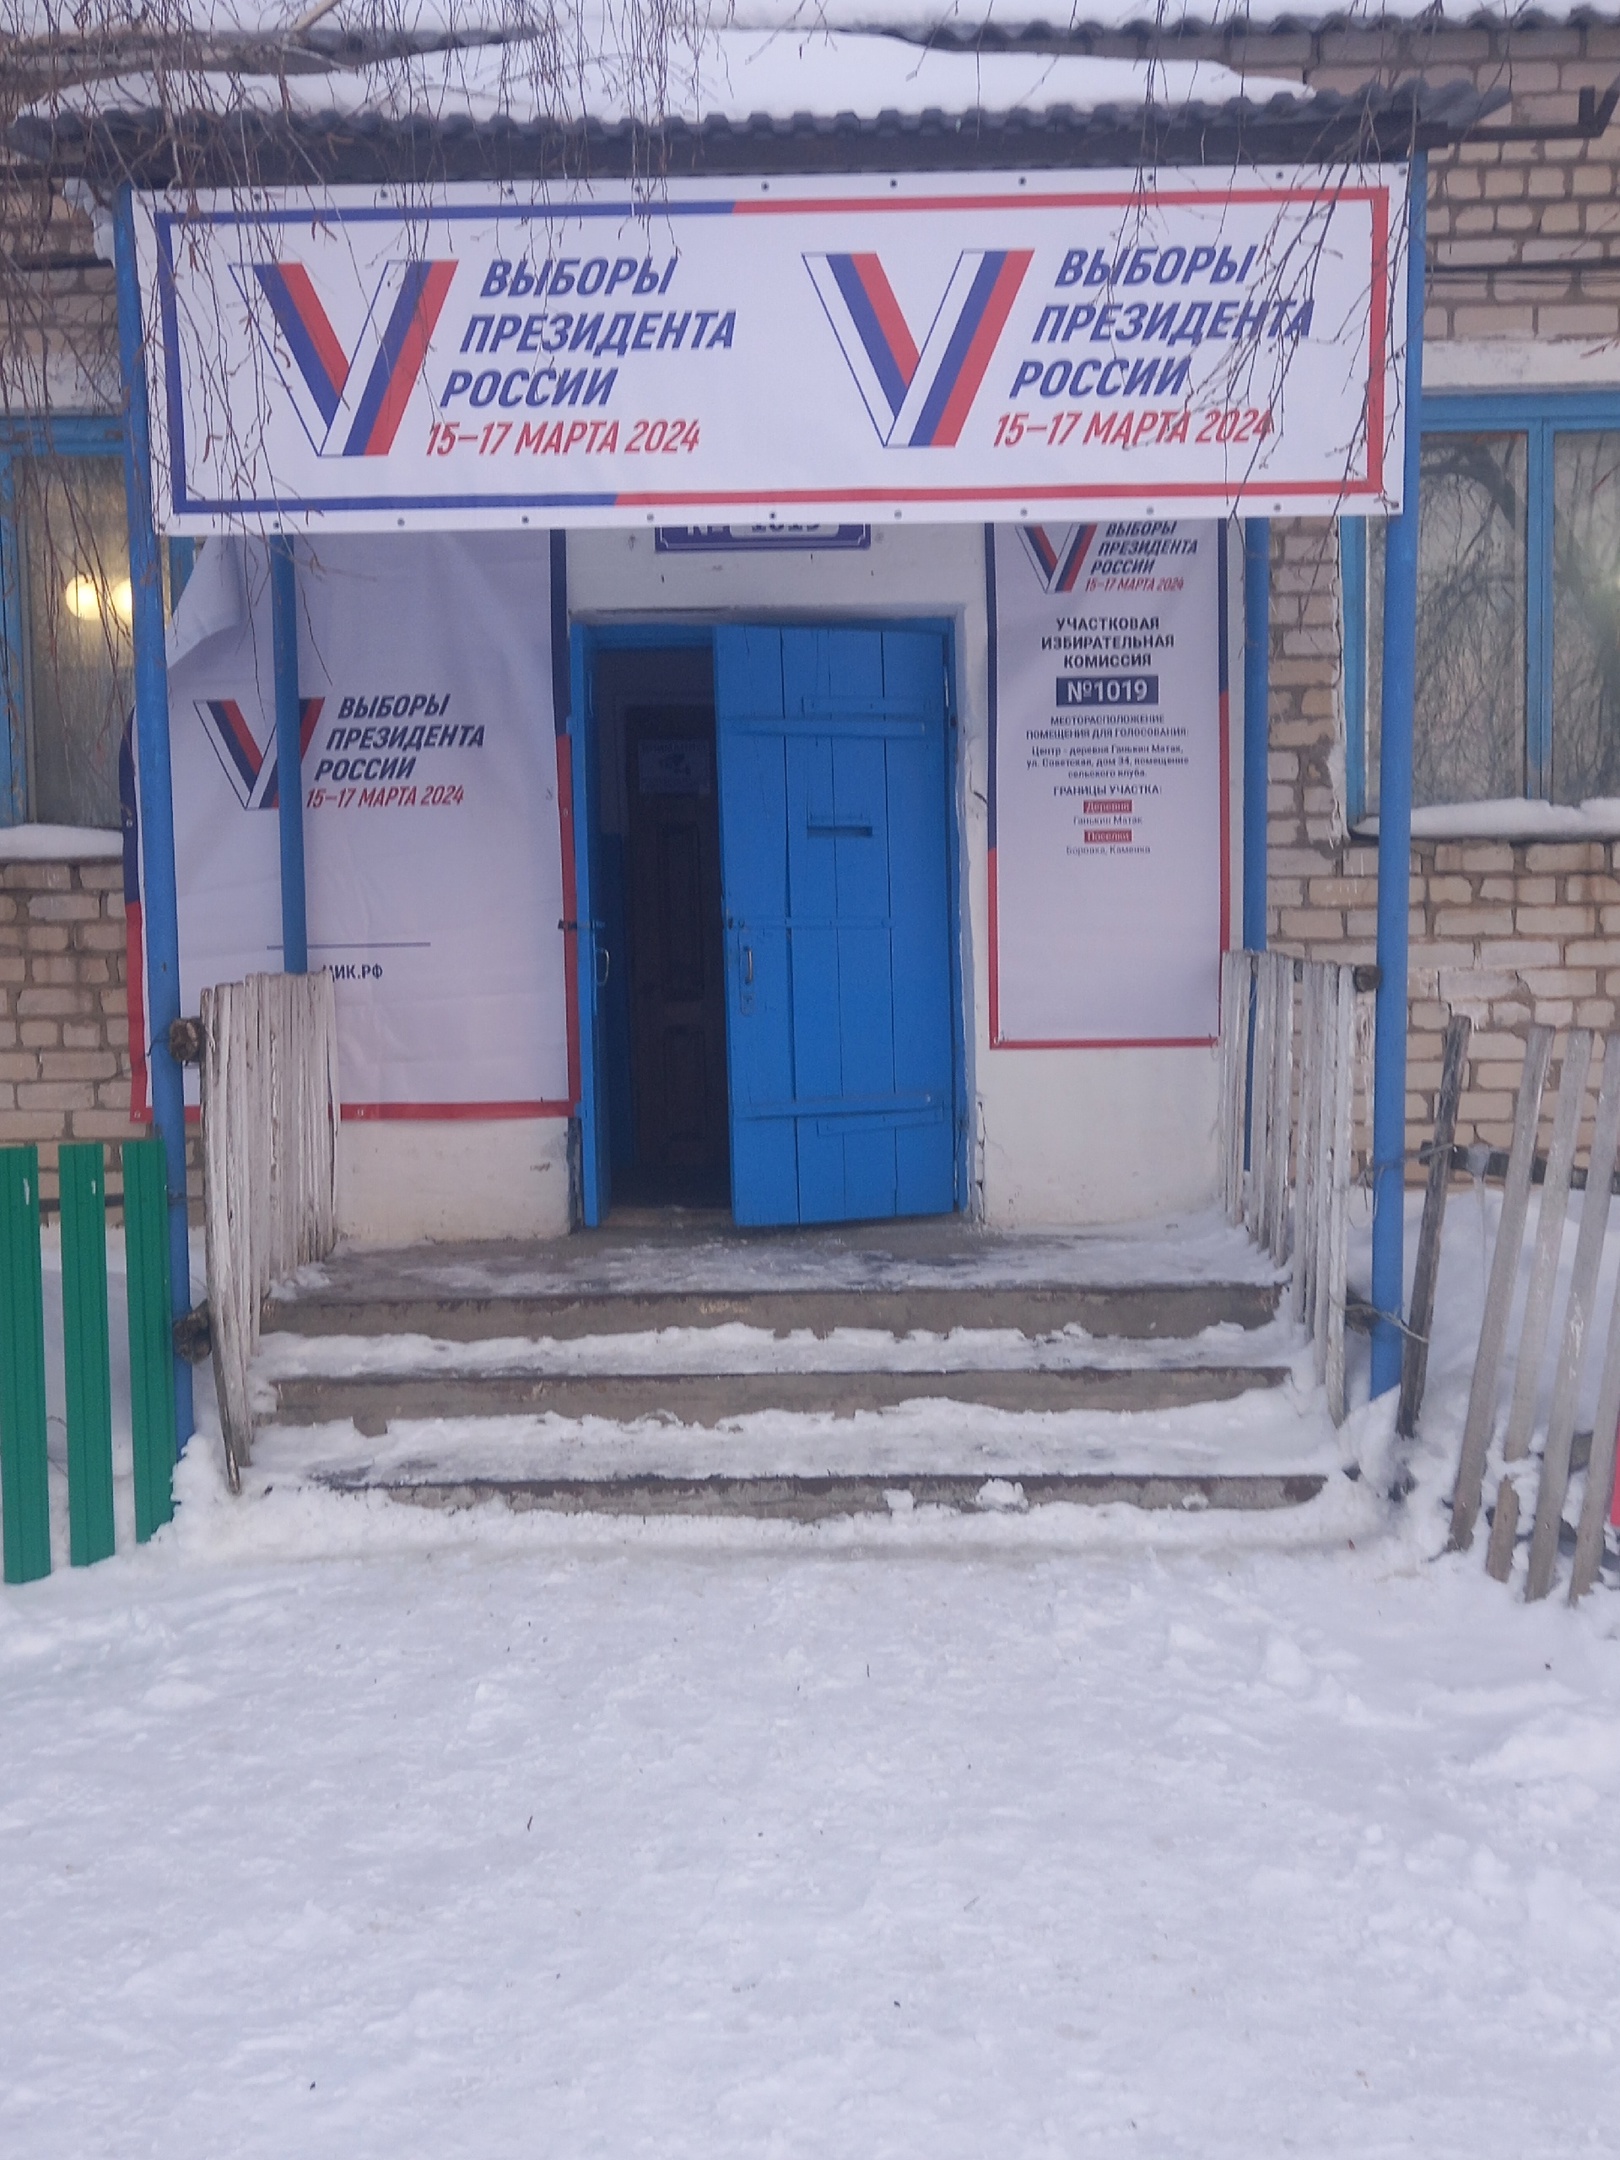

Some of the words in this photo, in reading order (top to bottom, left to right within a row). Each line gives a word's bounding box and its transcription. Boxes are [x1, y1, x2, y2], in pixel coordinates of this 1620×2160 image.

[480, 255, 679, 298] ВЫБОРЫ
[1055, 244, 1259, 289] ВЫБОРЫ
[459, 309, 737, 357] ПРЕЗИДЕНТА
[1031, 299, 1316, 347] ПРЕЗИДЕНТА
[438, 367, 620, 409] РОССИИ
[1009, 356, 1192, 400] РОССИИ
[514, 420, 618, 456] МАРТА
[623, 418, 701, 455] 2024
[1082, 410, 1191, 446] МАРТА
[1194, 408, 1274, 445] 2024
[1106, 520, 1178, 538] ВЫБОРЫ
[1098, 539, 1198, 557] ПРЕЗИДЕНТА
[1090, 558, 1156, 575] РОССИИ
[1117, 577, 1155, 592] МАРТА
[1157, 576, 1184, 592] 2024
[1056, 617, 1160, 632] УЧАСТКОВАЯ
[1041, 634, 1175, 651] ИЗБИРАТЕЛЬНАЯ
[1063, 653, 1152, 669] КОМИССИЯ
[338, 693, 451, 719] ВЫБОРЫ
[1050, 714, 1164, 726] МЕСТОРАСПОЛОЖЕНИЕ
[325, 724, 485, 752] ПРЕЗИДЕНТА
[1091, 728, 1113, 740] ДЛЯ
[313, 756, 417, 781] РОССИИ
[1095, 757, 1116, 769] дом
[357, 786, 418, 808] МАРТА
[420, 784, 464, 806] 2024
[1053, 785, 1108, 797] ГРАНИЦЫ
